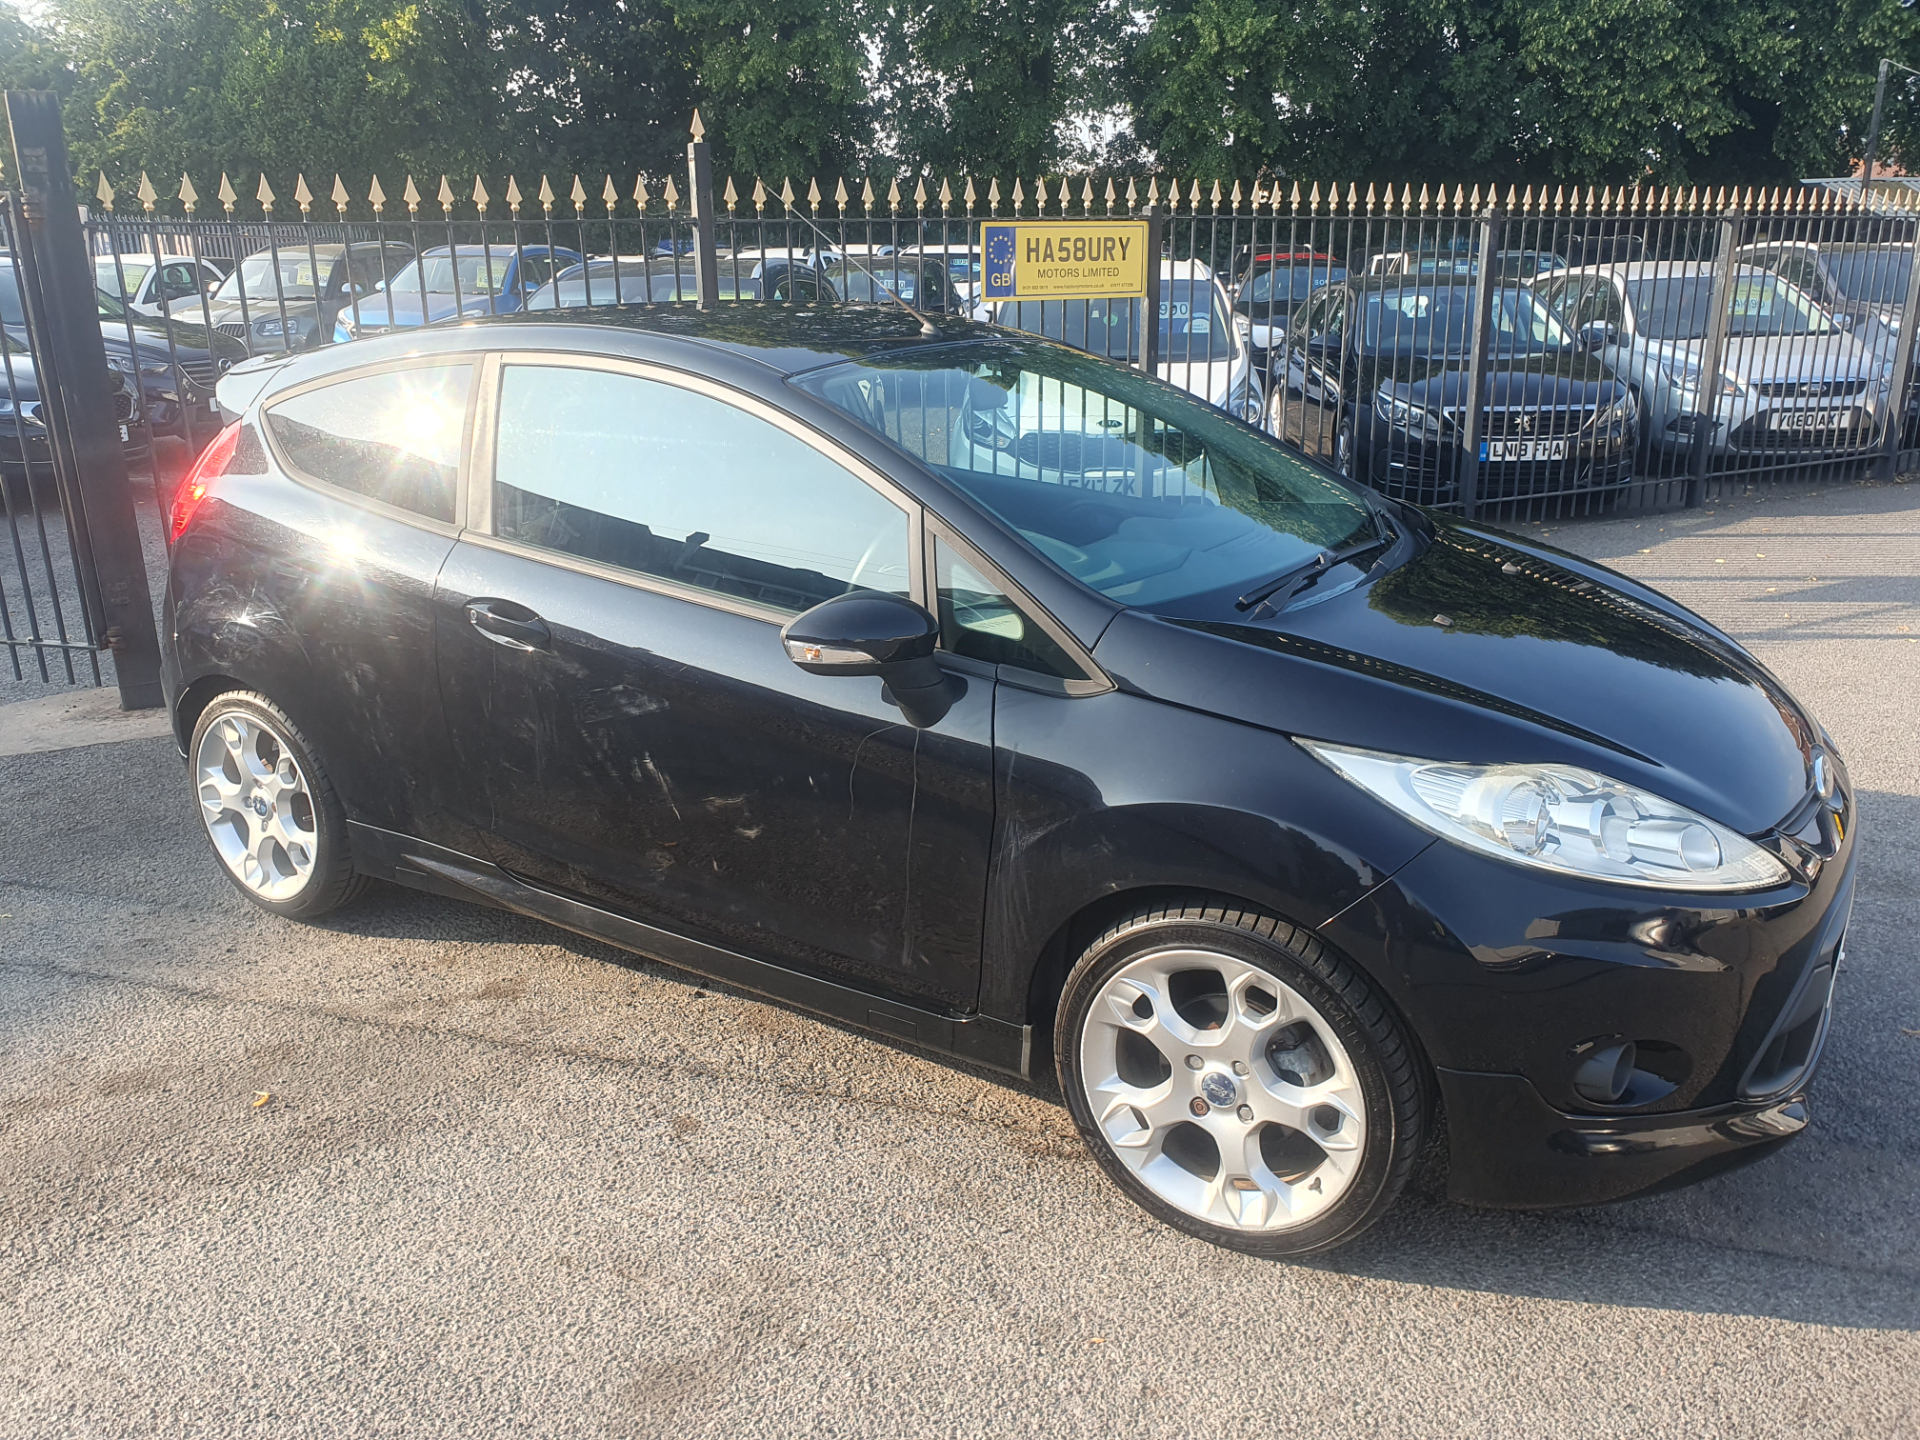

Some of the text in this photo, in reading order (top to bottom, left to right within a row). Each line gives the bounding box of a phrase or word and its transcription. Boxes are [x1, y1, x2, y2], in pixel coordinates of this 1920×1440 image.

[1026, 237, 1131, 263] HA58URY
[991, 273, 1011, 287] GB
[1037, 267, 1120, 279] MOTORS LIMITED
